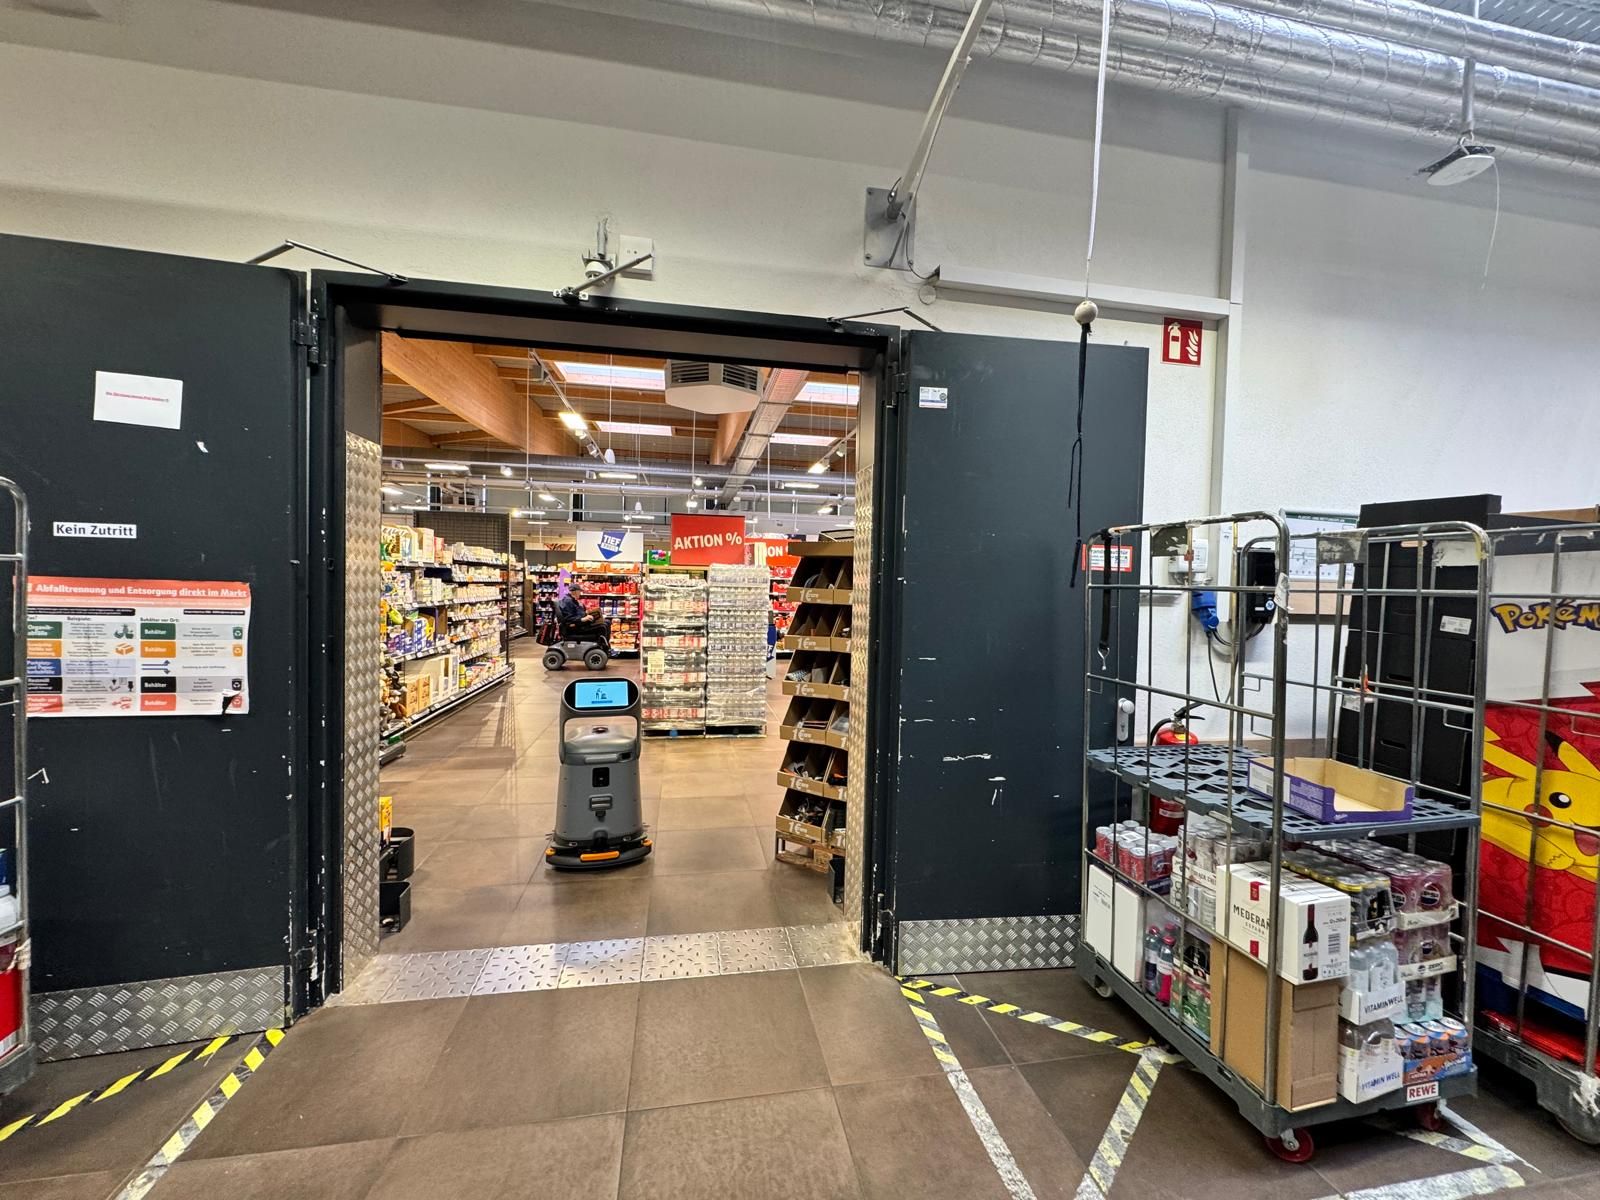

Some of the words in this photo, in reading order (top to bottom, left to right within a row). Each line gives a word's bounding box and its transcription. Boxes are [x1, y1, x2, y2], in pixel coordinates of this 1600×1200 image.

[56, 524, 86, 535] Kein
[90, 525, 134, 537] Zutritt
[603, 534, 622, 546] TIEF
[673, 533, 723, 551] AKTION
[725, 532, 743, 546] %
[36, 584, 106, 596] Abfalltrennung
[108, 586, 126, 595] und
[127, 586, 177, 598] Entsorgung
[179, 588, 206, 598] direkt
[208, 588, 219, 597] im
[220, 588, 248, 598] Markt
[1364, 999, 1388, 1014] VITAMIN
[1361, 1077, 1385, 1091] VITAMIN
[1386, 1071, 1401, 1083] WELL
[1409, 1084, 1437, 1099] REWE
